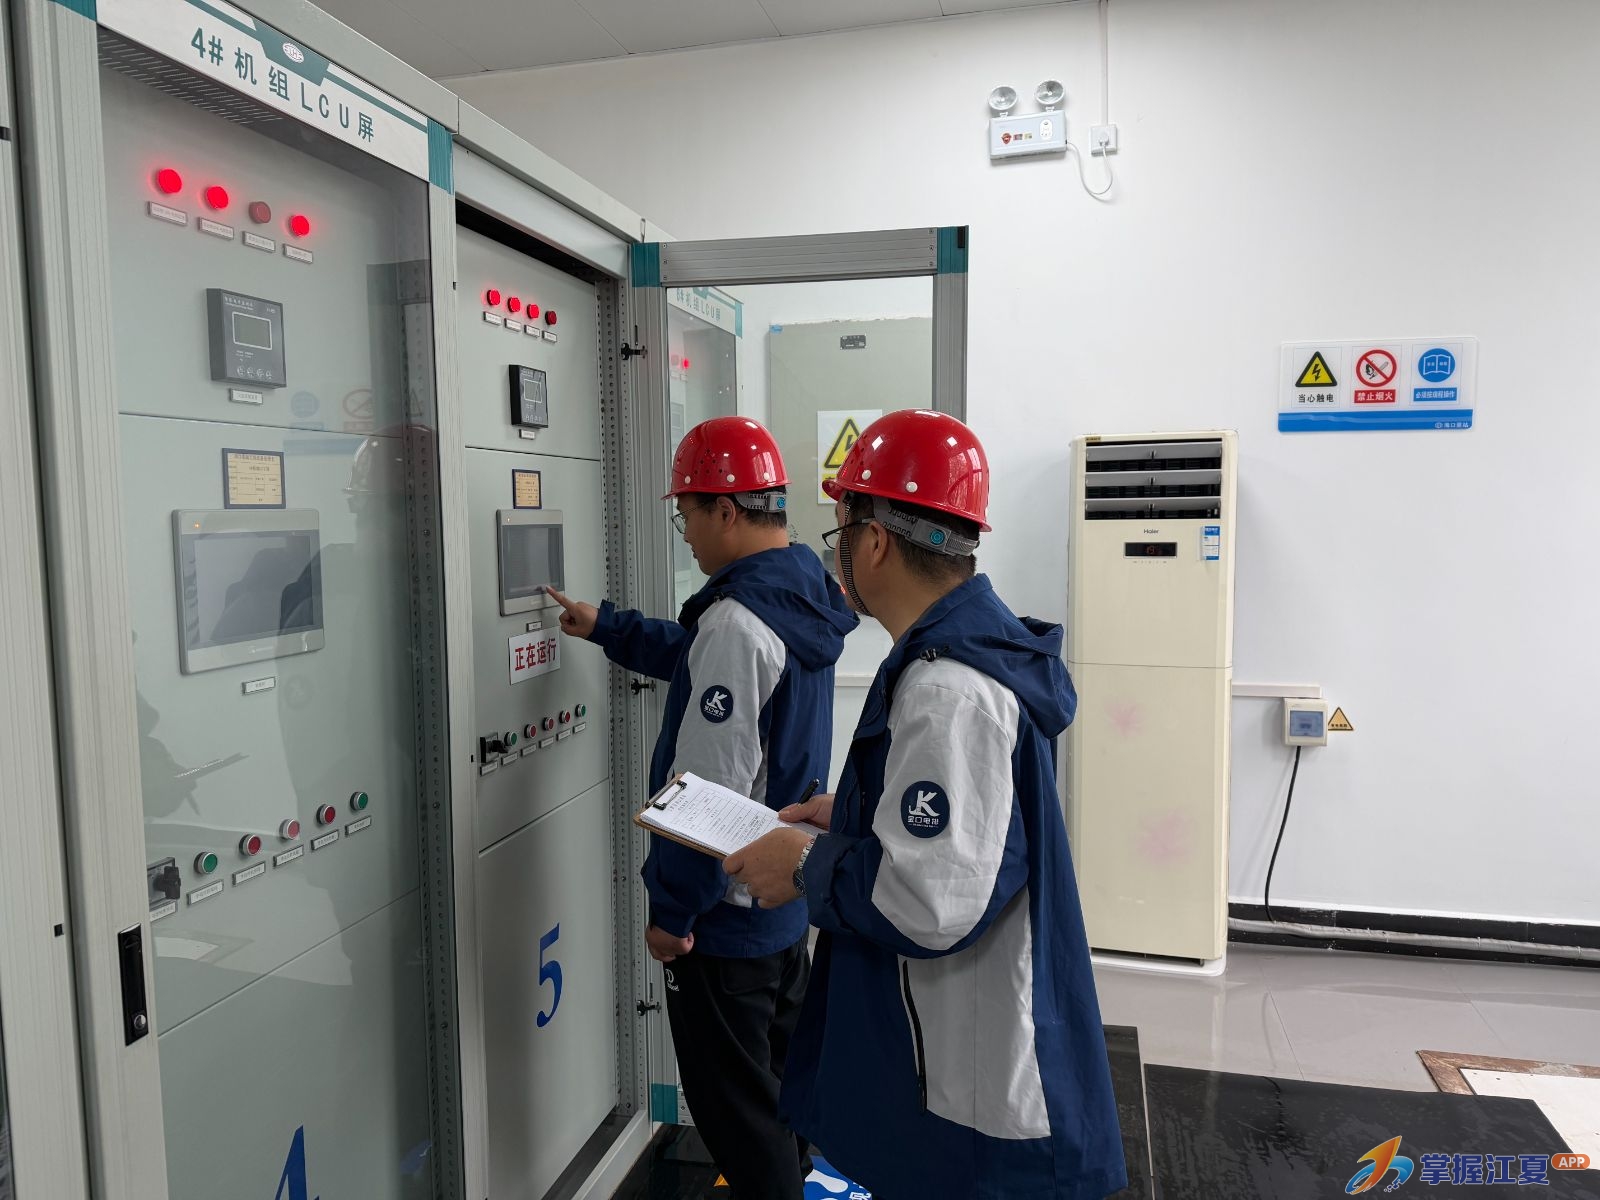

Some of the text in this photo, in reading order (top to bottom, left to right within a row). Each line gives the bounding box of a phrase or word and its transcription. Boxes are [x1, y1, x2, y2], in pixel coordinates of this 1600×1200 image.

[191, 27, 375, 143] 4#机组LCU屏
[1298, 393, 1335, 403] 当心触电
[1357, 391, 1393, 401] 禁止烟火
[514, 637, 557, 672] 正在运行
[536, 922, 563, 1028] 5
